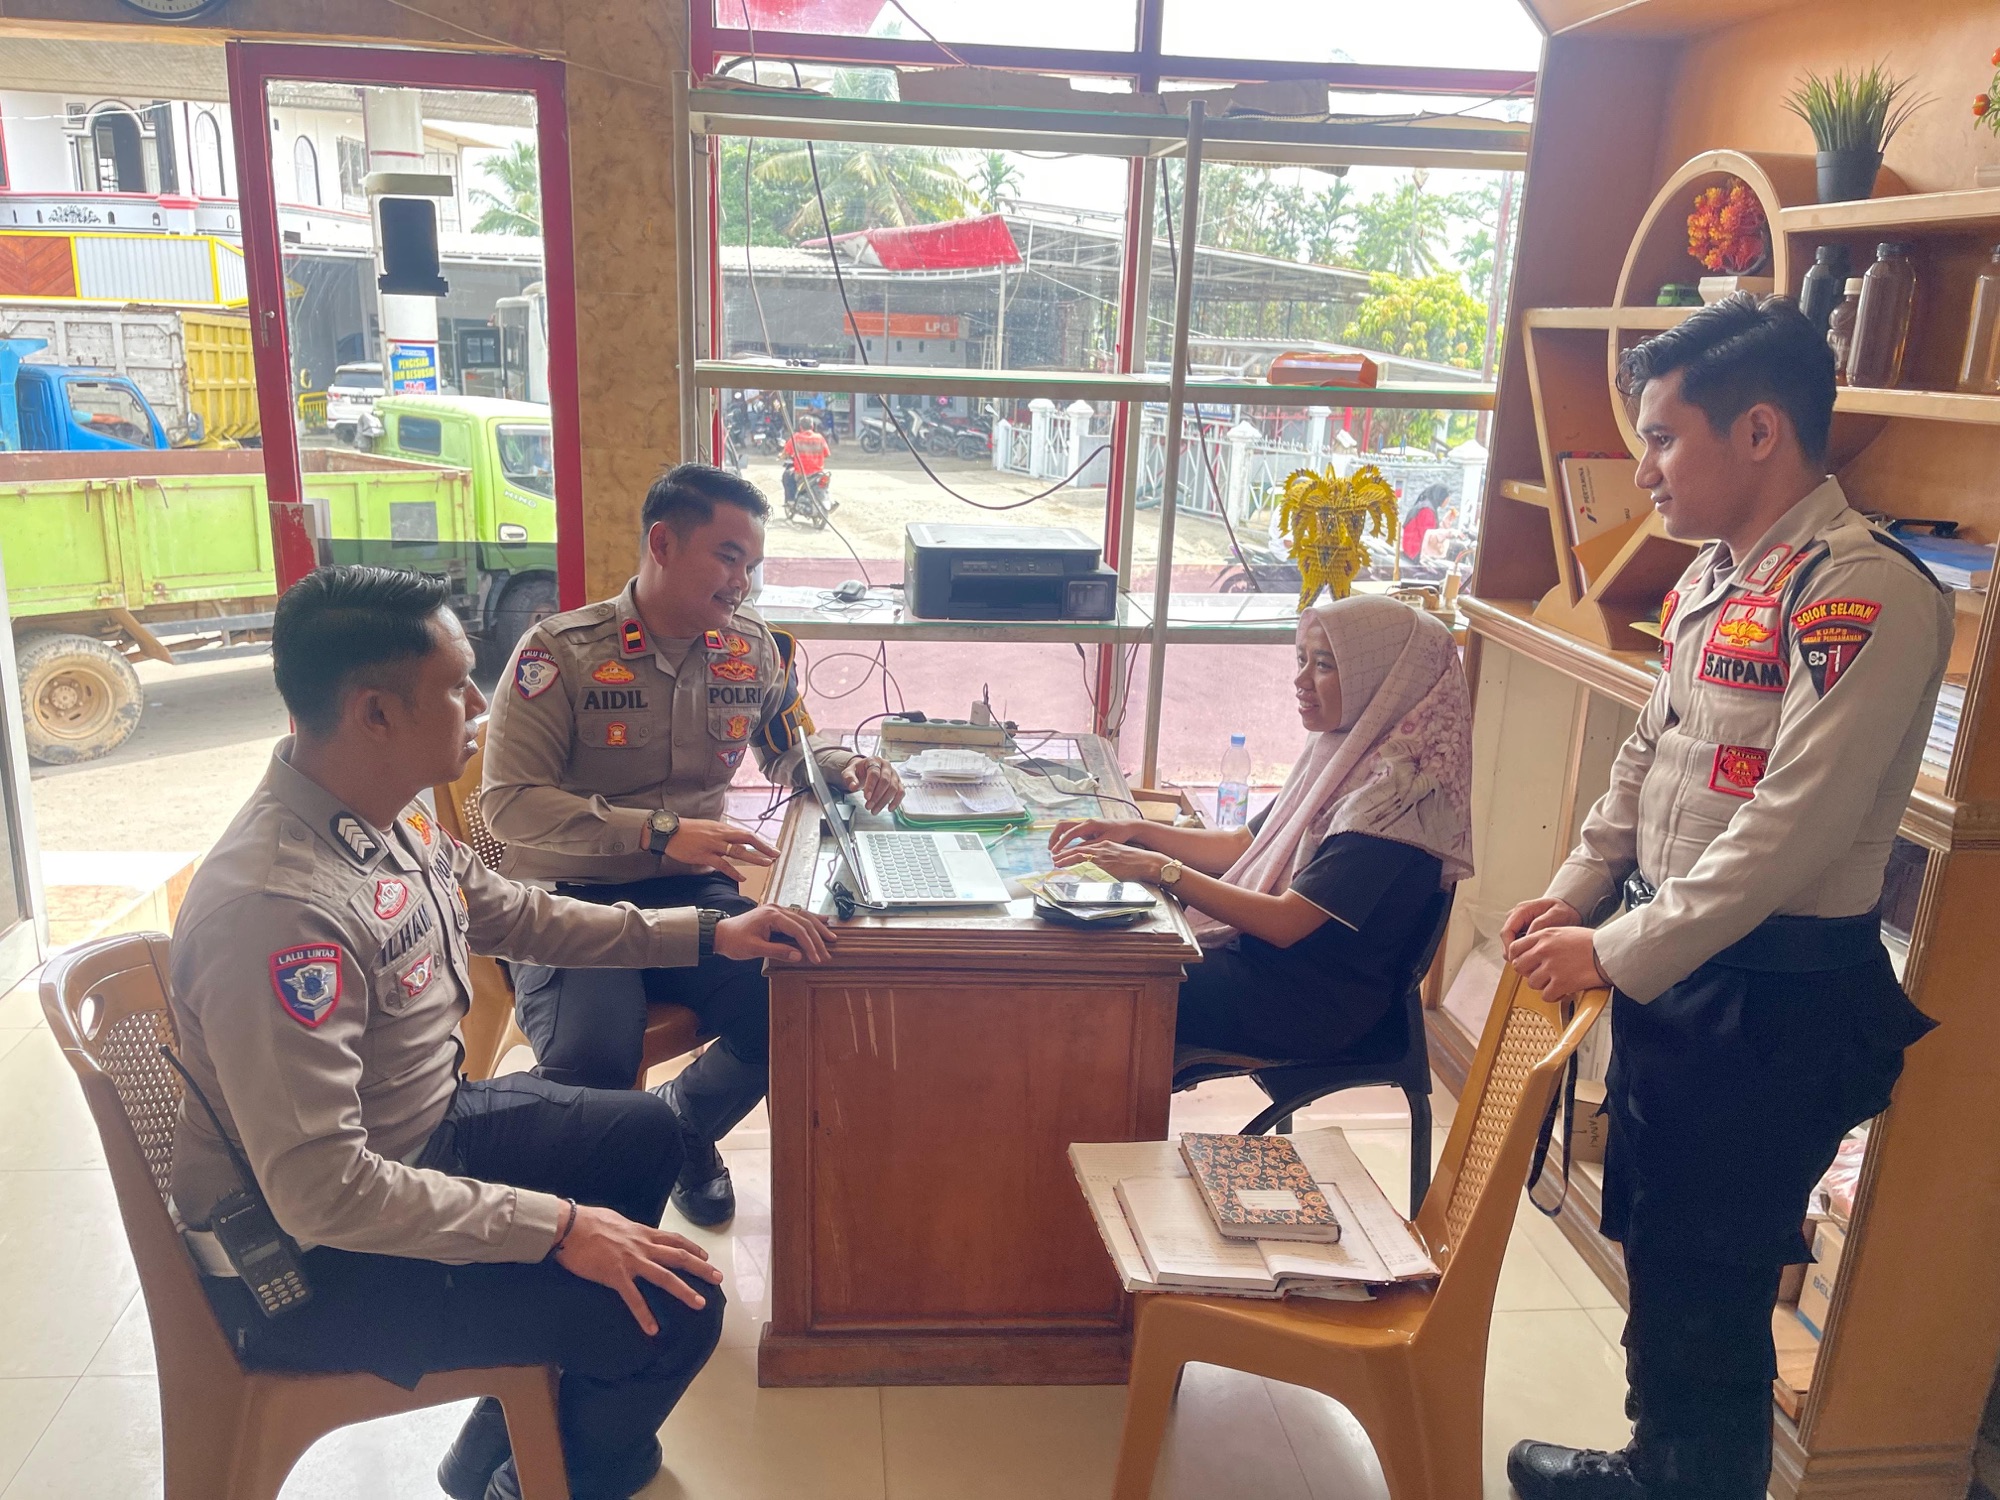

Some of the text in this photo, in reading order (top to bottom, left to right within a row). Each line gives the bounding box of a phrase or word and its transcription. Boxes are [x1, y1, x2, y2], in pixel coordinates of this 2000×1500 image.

[925, 322, 950, 333] LPG
[1578, 467, 1590, 503] PERTAMINA
[504, 490, 537, 508] HINO
[1796, 602, 1874, 626] SOLOK SELATAN
[539, 651, 556, 663] LINTA
[1704, 653, 1783, 687] SATPAM
[584, 690, 648, 710] AIDIL
[708, 687, 762, 704] POLRI
[382, 903, 432, 967] ILHAM
[278, 949, 335, 964] LALU LINTAS
